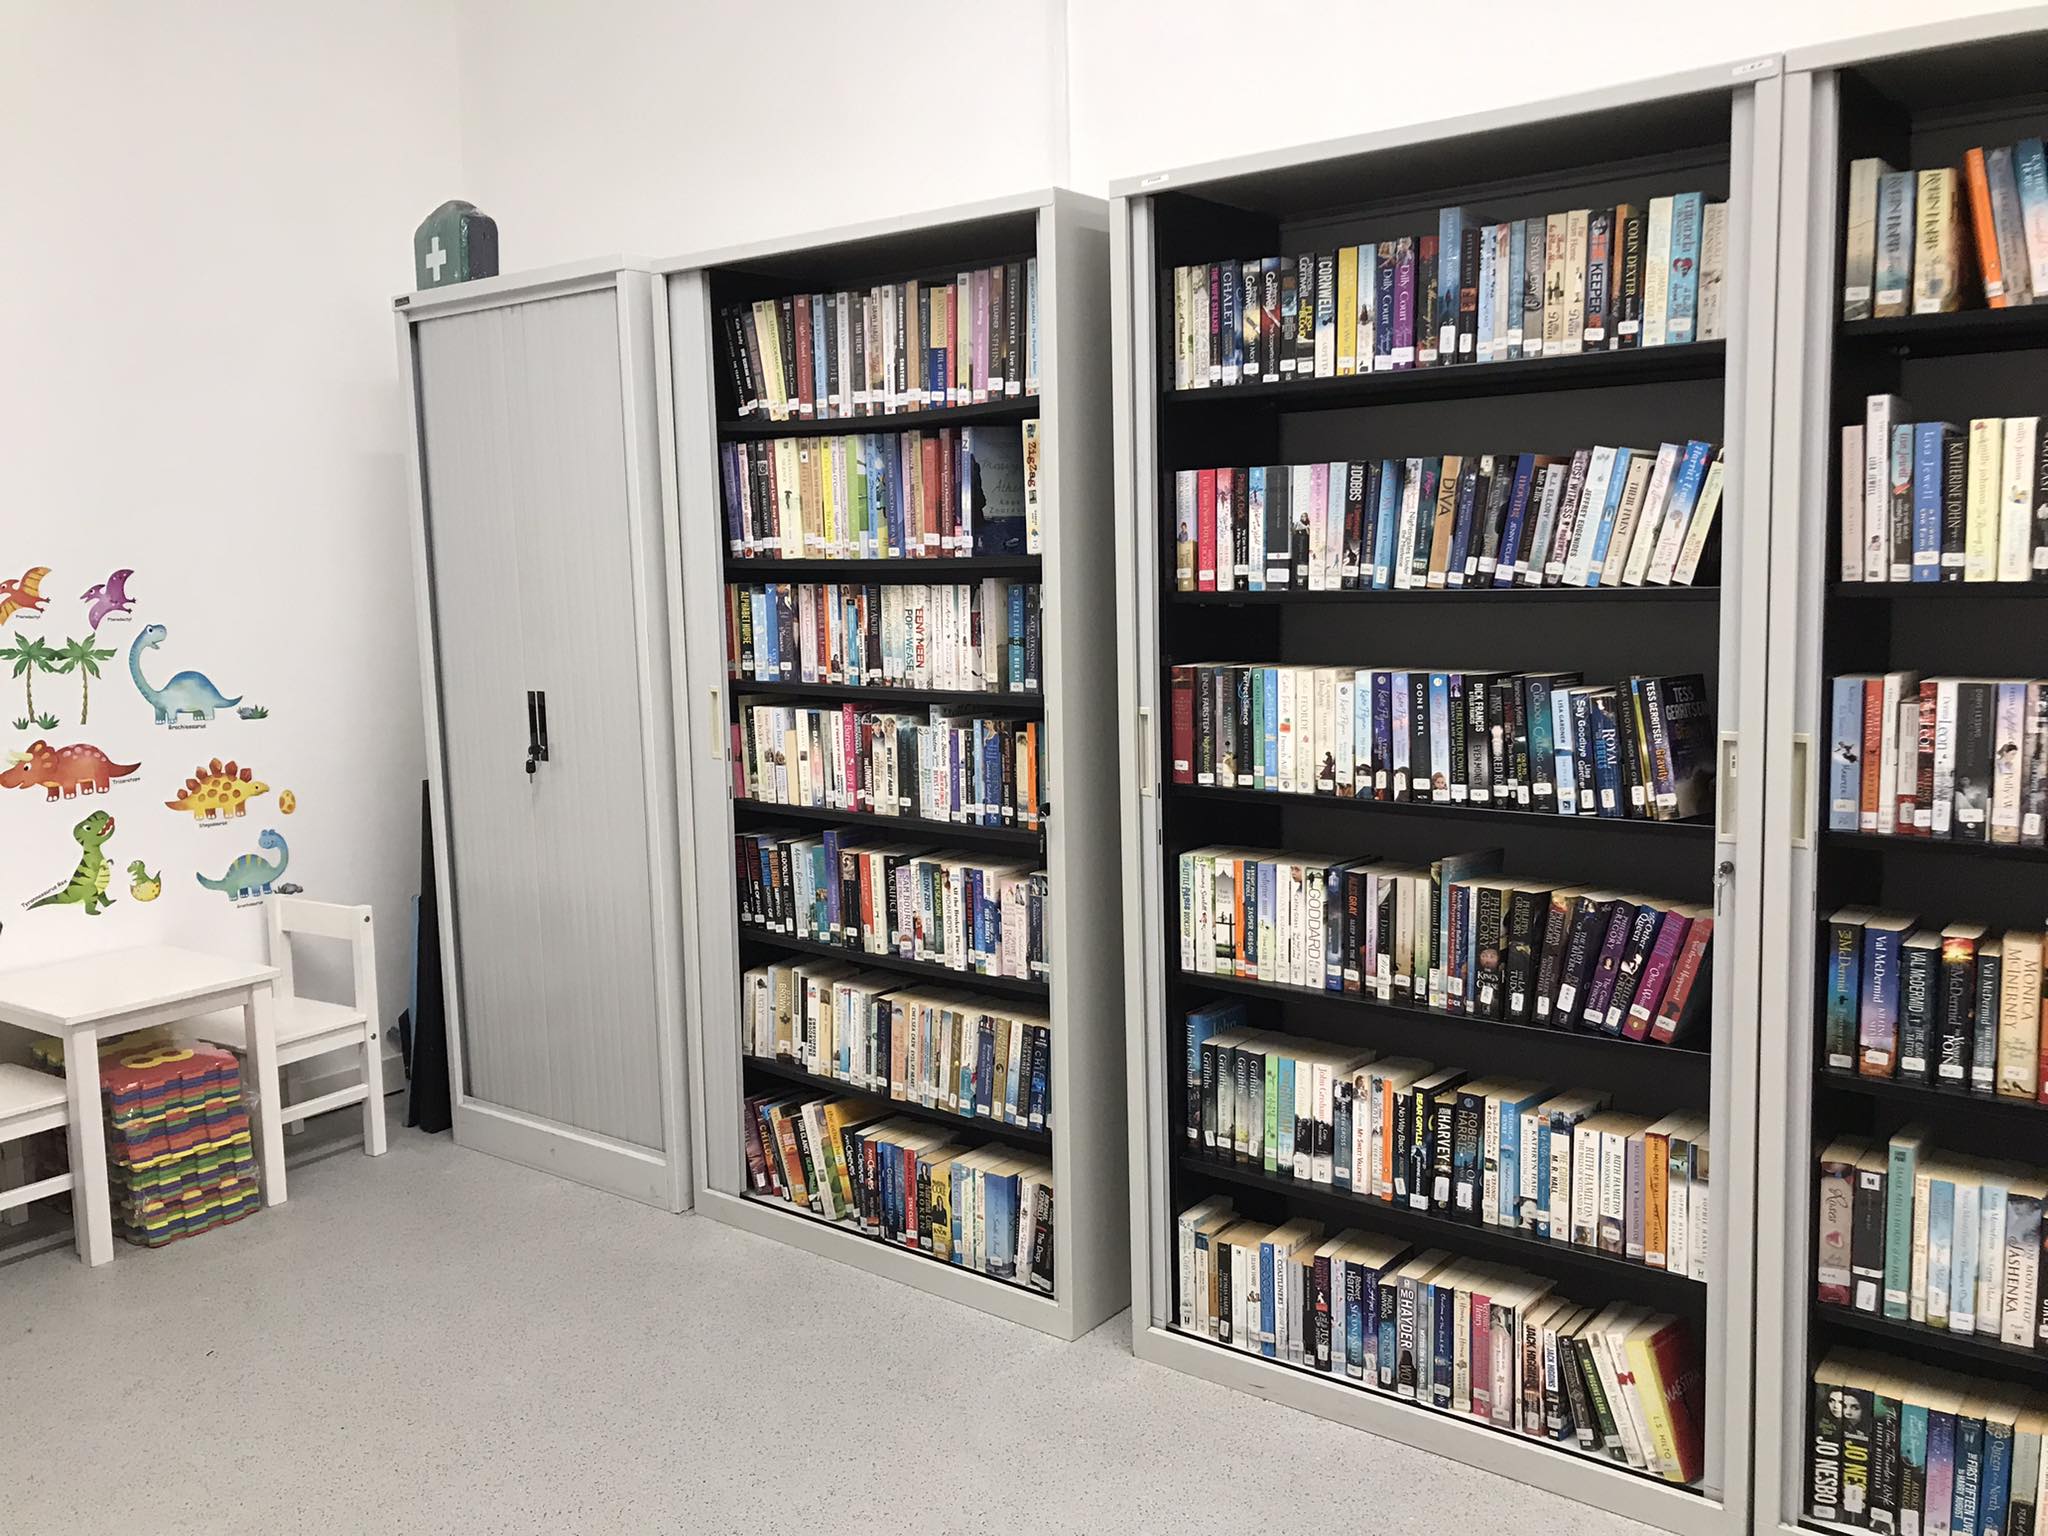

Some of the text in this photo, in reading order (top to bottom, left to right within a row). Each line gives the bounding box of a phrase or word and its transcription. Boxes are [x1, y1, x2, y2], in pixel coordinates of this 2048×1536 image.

[1299, 257, 1309, 298] Cornwell
[1530, 237, 1539, 295] SYLVIA DAY
[1625, 220, 1638, 296] COLIN DEXTER
[1223, 272, 1232, 328] CHALET
[1318, 262, 1332, 317] CORNWELL
[1381, 269, 1392, 324] Dilly Court
[1397, 265, 1410, 321] Dilly Court
[1589, 263, 1602, 314] KEEPER
[1027, 442, 1037, 487] ZigZag
[1351, 469, 1363, 500] DOBBS
[1921, 431, 1935, 499] Lisa Jewell
[1948, 442, 1963, 528] KATHERINE JOHN
[1438, 478, 1455, 516] DIVA
[1563, 461, 1583, 519] LOST WITNESS
[1618, 482, 1639, 535] THEIR FINEST
[1406, 512, 1416, 553] Nightingales
[1507, 521, 1517, 541] JENNY
[1570, 489, 1592, 557] JEFFREY EUGENIDES
[741, 592, 750, 623] ALPHABET
[905, 609, 913, 629] POP
[915, 608, 924, 634] EENY
[1455, 701, 1463, 751] CHRISTOPHER
[1474, 683, 1484, 732] DICK FRANCIS
[1576, 700, 1592, 757] Say Goodbye
[1619, 681, 1631, 734] LISA GENOVA
[1645, 682, 1662, 744] TESS GERRITSEN
[1602, 729, 1617, 769] ROYAL
[1920, 722, 1934, 753] Leon
[1937, 720, 1952, 750] Leon
[1473, 764, 1481, 785] MONEY
[1493, 756, 1503, 772] RED
[1656, 748, 1668, 781] Gravity
[781, 851, 789, 886] BLOODLINE
[888, 869, 896, 912] SACRIFICE
[1349, 896, 1357, 915] GRAY
[1308, 888, 1321, 958] GODDARD
[1480, 891, 1490, 948] GREGORY
[1489, 897, 1499, 945] PHILIPPA
[1513, 896, 1523, 936] GREGORY
[1521, 900, 1530, 934] PHILIPPA
[1552, 912, 1563, 946] PHILIPPA
[1606, 907, 1624, 949] GREGORY
[1615, 916, 1628, 945] PHILIPPA
[1632, 913, 1649, 942] Queen
[1637, 924, 1655, 949] Other
[1567, 943, 1578, 972] RIVERS
[1873, 936, 1887, 1003] Val McDermid
[1910, 951, 1926, 968] VAL
[1948, 968, 1962, 1025] McDermid
[1980, 962, 1994, 1024] Val McDermid
[2021, 960, 2037, 1021] MONICA
[1186, 1024, 1195, 1087] John Grisham
[1202, 1052, 1212, 1088] Griffiths
[1249, 1060, 1258, 1098] Griffiths
[1318, 1069, 1327, 1119] John Grisham
[1399, 1107, 1405, 1118] No
[1457, 1110, 1467, 1152] HARRIS
[760, 1125, 770, 1154] CHILD
[800, 1132, 809, 1154] CLANCY
[1437, 1115, 1451, 1161] HARVEY
[846, 1145, 855, 1176] Cleeves
[1584, 1147, 1595, 1217] RUTH HAMILTON
[1612, 1155, 1621, 1214] RUTH HAMILTON
[1035, 1233, 1045, 1262] The Drop
[1347, 1270, 1356, 1301] Harris
[1401, 1300, 1413, 1348] HAYDER
[1526, 1326, 1537, 1385] JACK HIGGINS
[1547, 1349, 1556, 1388] JACK HIGGINS
[1583, 1359, 1593, 1373] MARY
[1844, 1440, 1867, 1457] JO
[1990, 1441, 2005, 1471] Queen
[1814, 1437, 1839, 1504] JO NESBO
[1965, 1459, 1978, 1515] FIRST FIFTEEN
[1954, 1475, 1966, 1519] HARRY AUGUST
[1987, 1485, 2001, 1511] North
